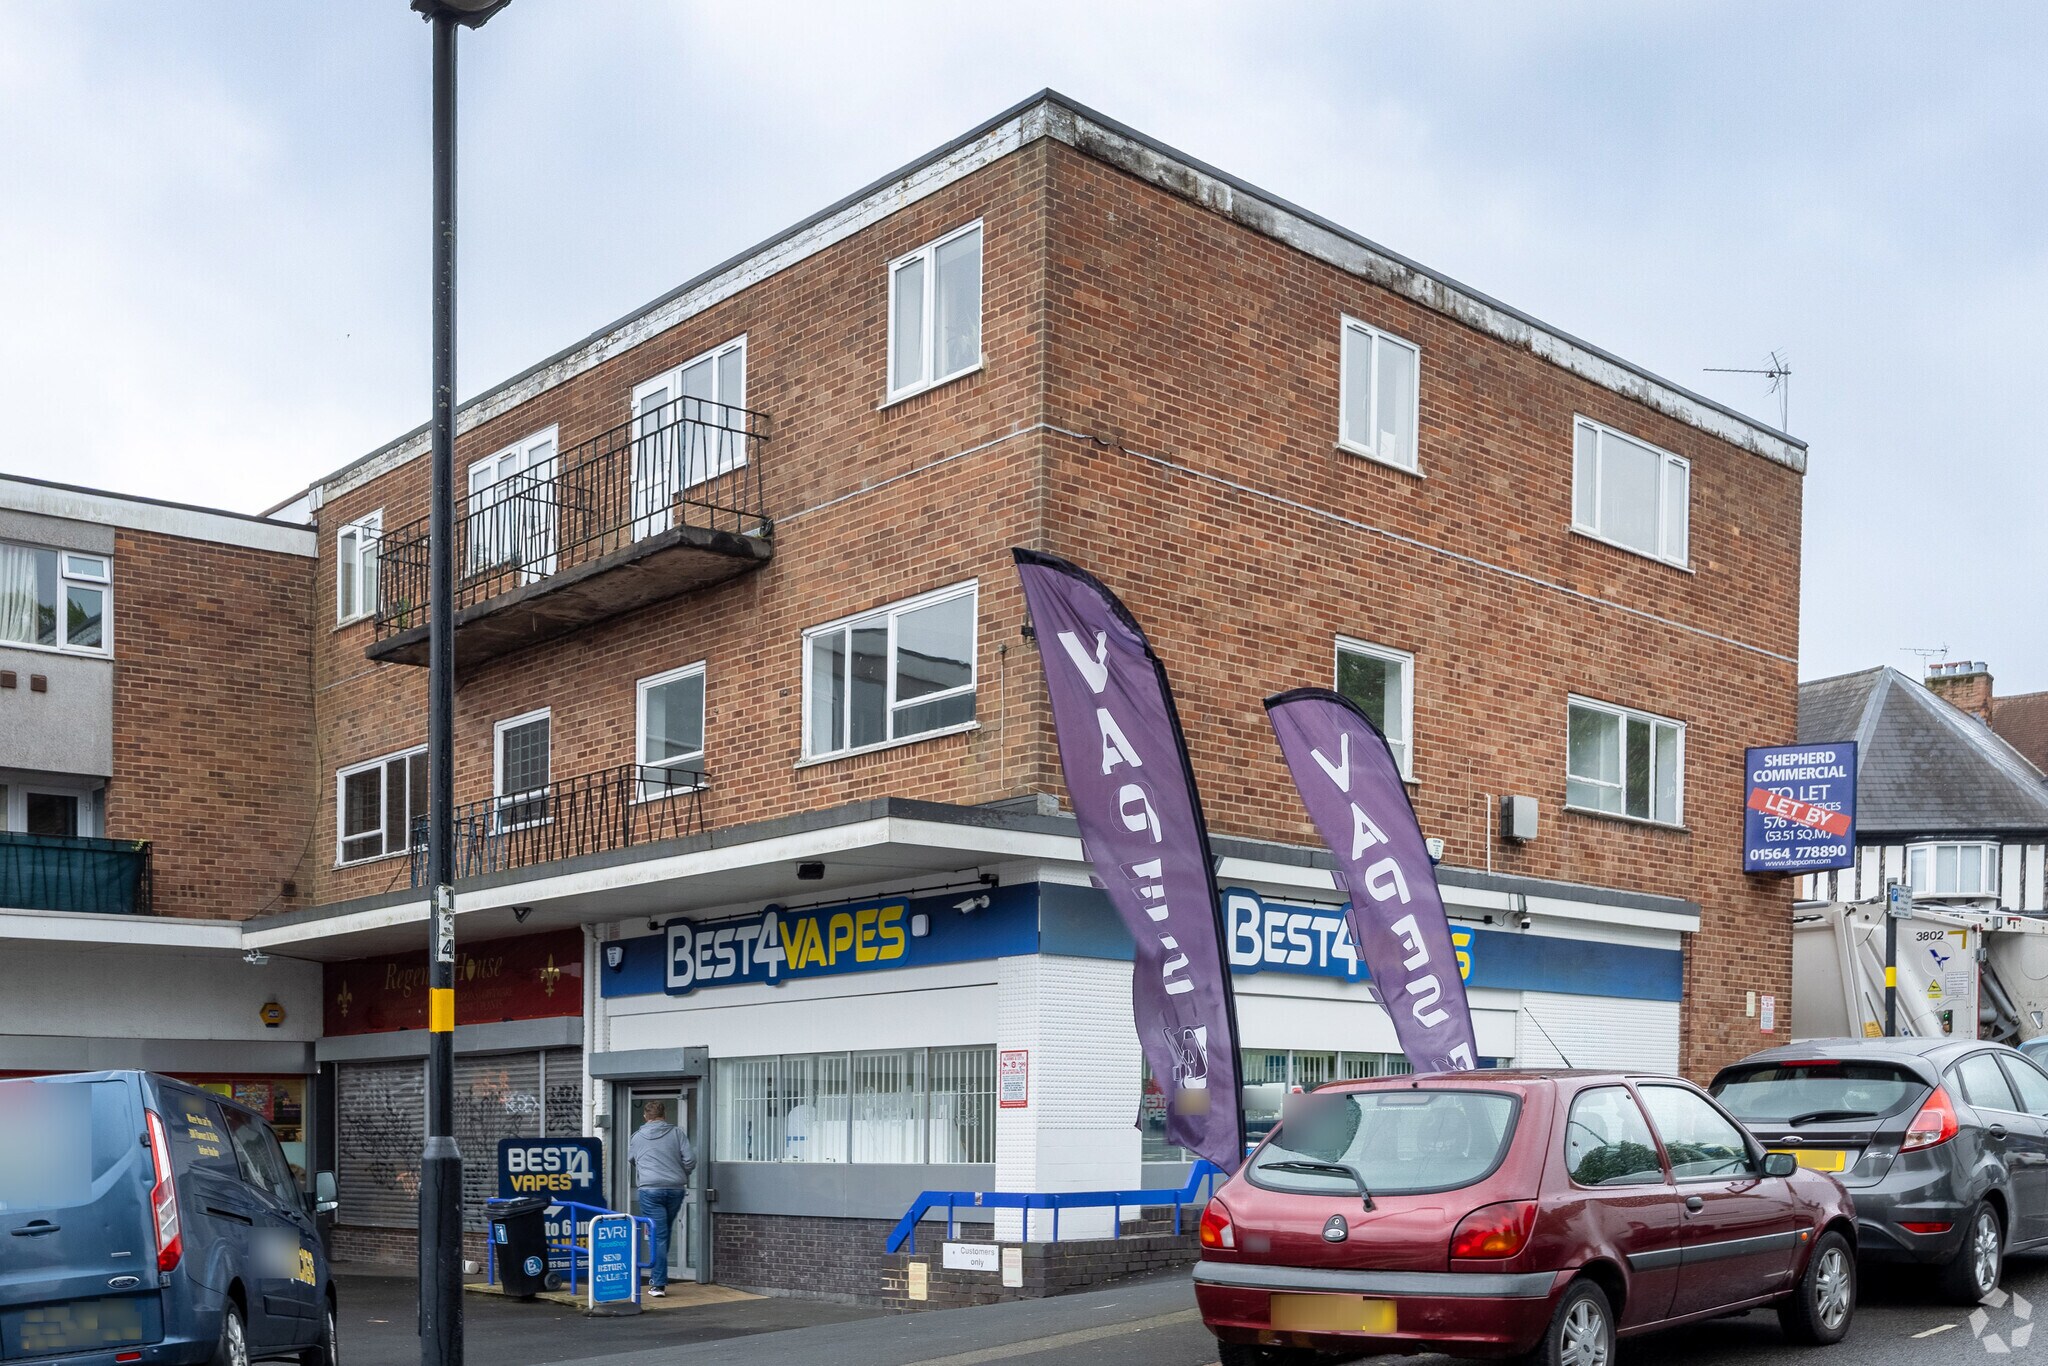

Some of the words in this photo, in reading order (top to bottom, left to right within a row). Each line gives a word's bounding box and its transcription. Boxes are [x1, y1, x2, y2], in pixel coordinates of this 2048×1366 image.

[1764, 751, 1836, 767] SHEPHERD
[1752, 765, 1847, 782] COMMERCIAL
[1768, 786, 1795, 800] TO
[1799, 784, 1831, 801] LET
[1765, 794, 1804, 816] LET
[1805, 807, 1833, 826] BY
[1764, 816, 1788, 829] 576
[1765, 830, 1794, 843] (53.51
[1750, 847, 1791, 861] 01564
[1795, 844, 1847, 859] 778890
[1765, 858, 1832, 867] www.shepcom.com
[1916, 930, 1944, 942] 3802
[385, 962, 432, 999] Regen
[510, 1174, 572, 1192] VAPES
[603, 1253, 622, 1262] SEND
[960, 1246, 995, 1256] Customers
[597, 1262, 627, 1273] RETURN
[970, 1259, 985, 1267] only
